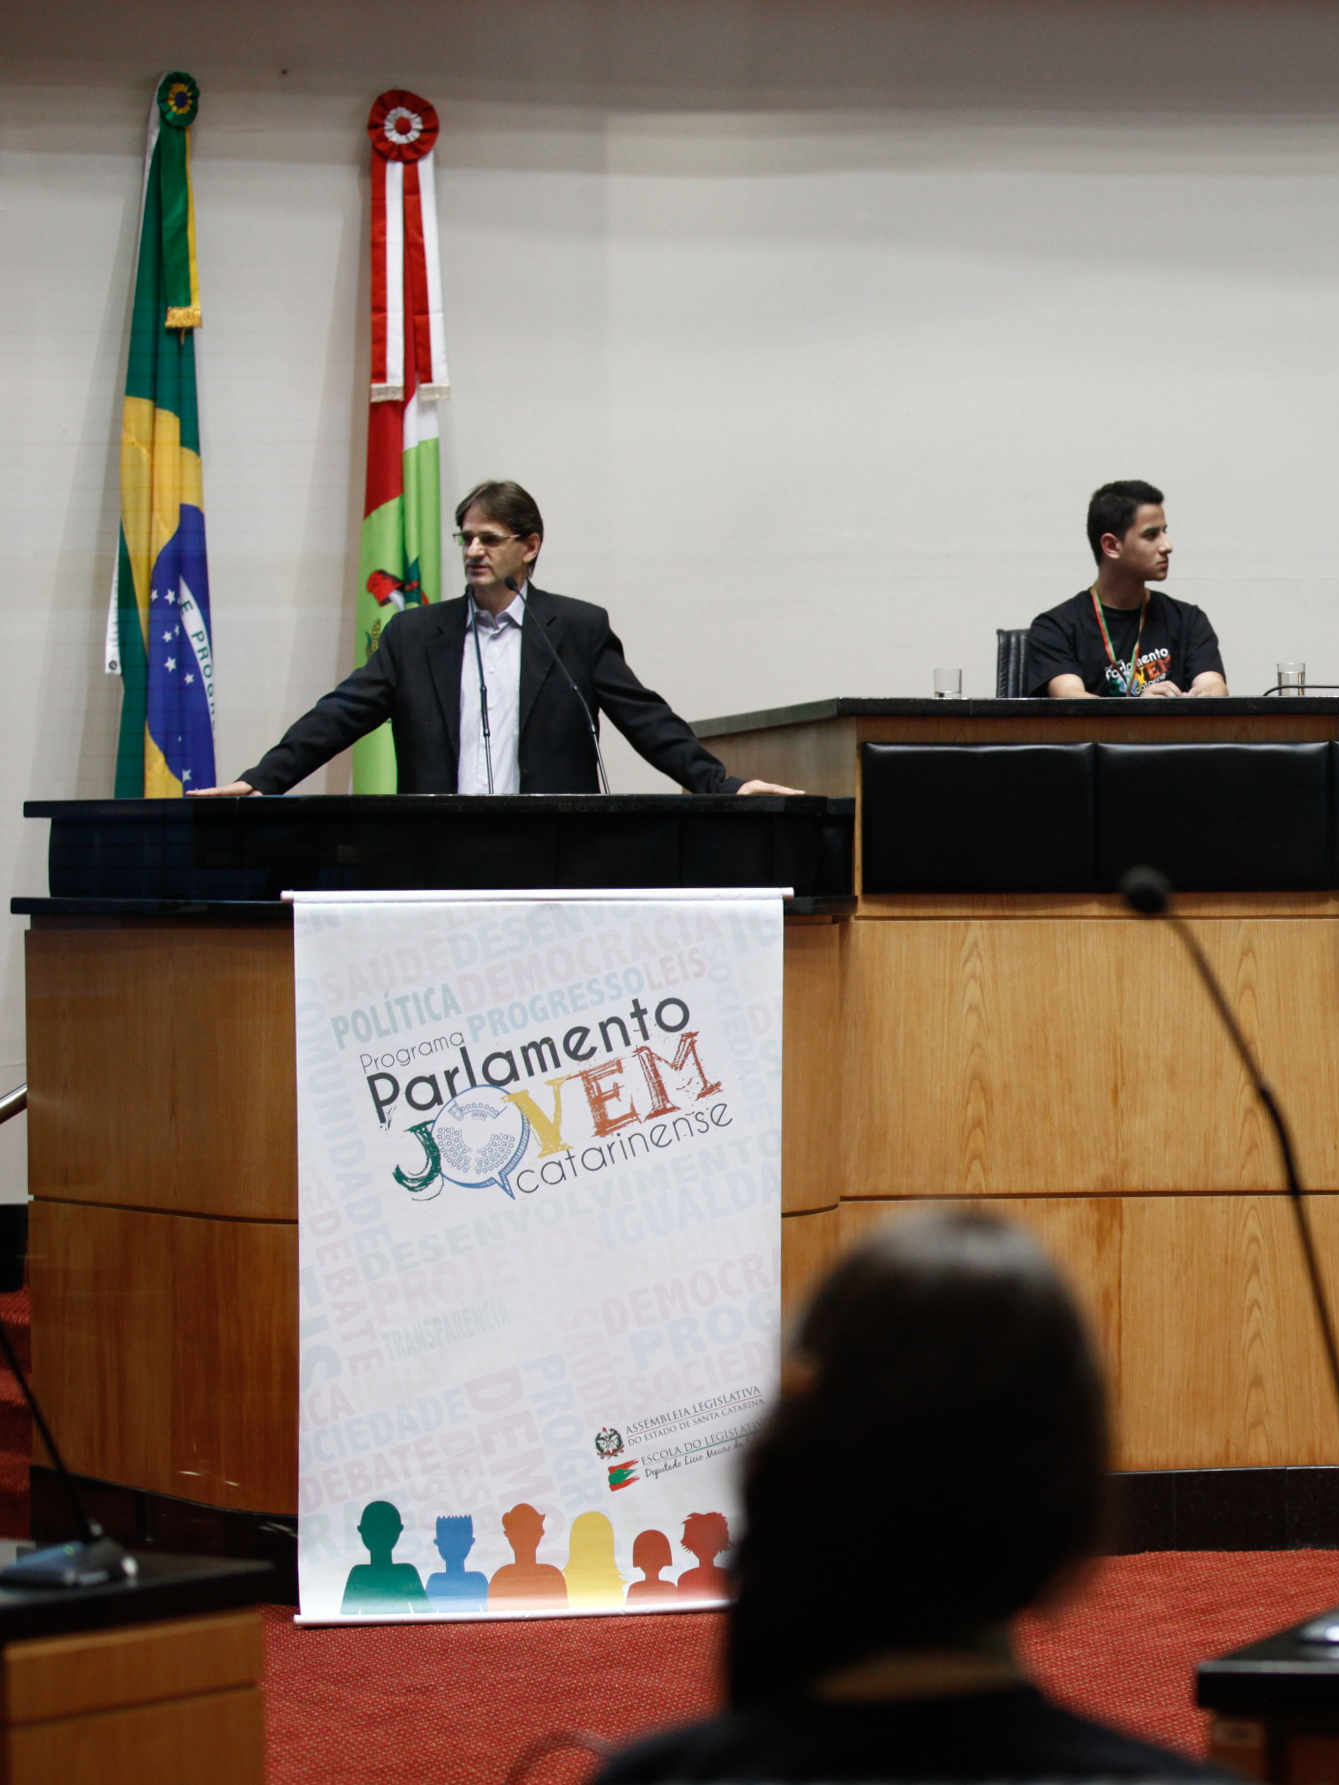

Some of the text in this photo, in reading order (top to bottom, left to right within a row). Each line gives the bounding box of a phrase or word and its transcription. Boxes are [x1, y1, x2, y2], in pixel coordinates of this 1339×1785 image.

[191, 630, 216, 730] PROG
[320, 938, 449, 1009] SAÚDE
[456, 905, 723, 1012] DEMOCRACIA
[643, 947, 706, 991] LEIS
[331, 983, 462, 1050] POLÍTICA
[466, 967, 645, 1043] PROGRESSO
[360, 1031, 465, 1075] Programa
[366, 997, 691, 1124] Parlamento
[392, 1031, 724, 1198] JOVEM
[516, 1102, 734, 1195] catarinense
[626, 1386, 761, 1435] ASSEMBLEIA LEGISLATIVA
[628, 1398, 765, 1447] DO ESTADO DE SANTA CATARINA
[641, 1446, 680, 1466] ESCOLA
[684, 1439, 702, 1452] DO
[645, 1461, 682, 1481] Deputado
